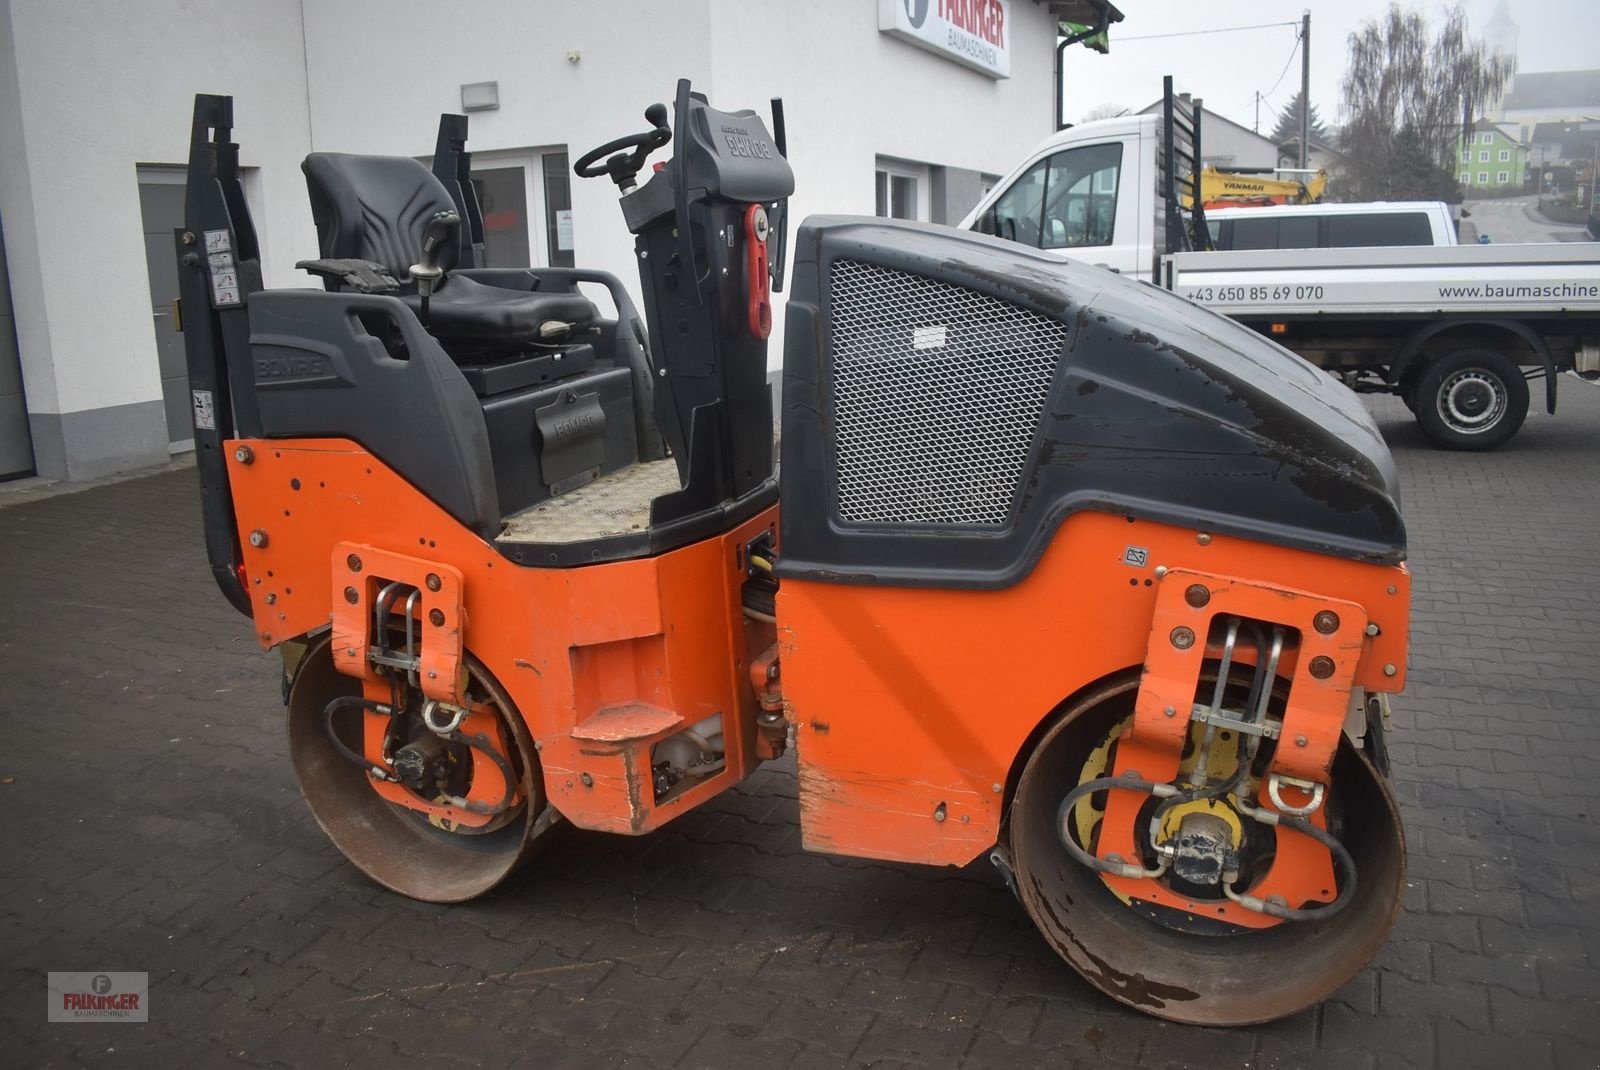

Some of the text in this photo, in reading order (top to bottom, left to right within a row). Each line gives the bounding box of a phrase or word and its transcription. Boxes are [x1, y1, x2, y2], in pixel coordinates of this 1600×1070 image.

[948, 28, 997, 65] BAUMASCHINEN
[1224, 182, 1265, 192] YANMAR
[1187, 285, 1324, 301] +43 650 85 69 070
[1438, 283, 1599, 298] www.baumaschine
